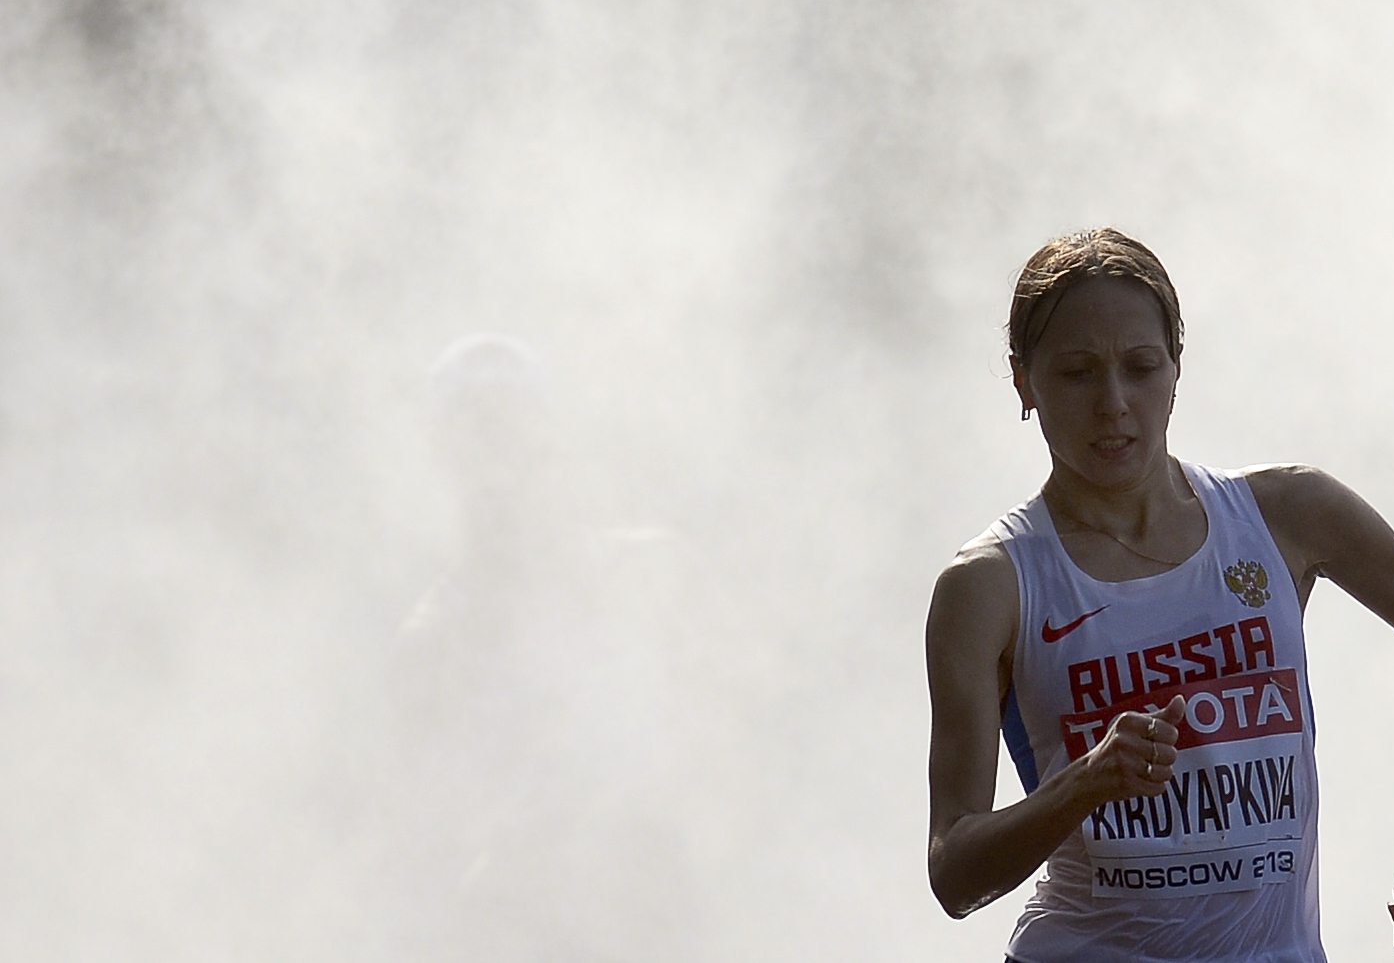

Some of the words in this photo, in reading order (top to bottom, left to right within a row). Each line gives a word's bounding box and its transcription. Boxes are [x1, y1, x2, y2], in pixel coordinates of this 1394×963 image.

[1068, 616, 1275, 713] RUSSIA
[1068, 683, 1293, 751] TOTA
[1098, 859, 1243, 888] MOSCOW
